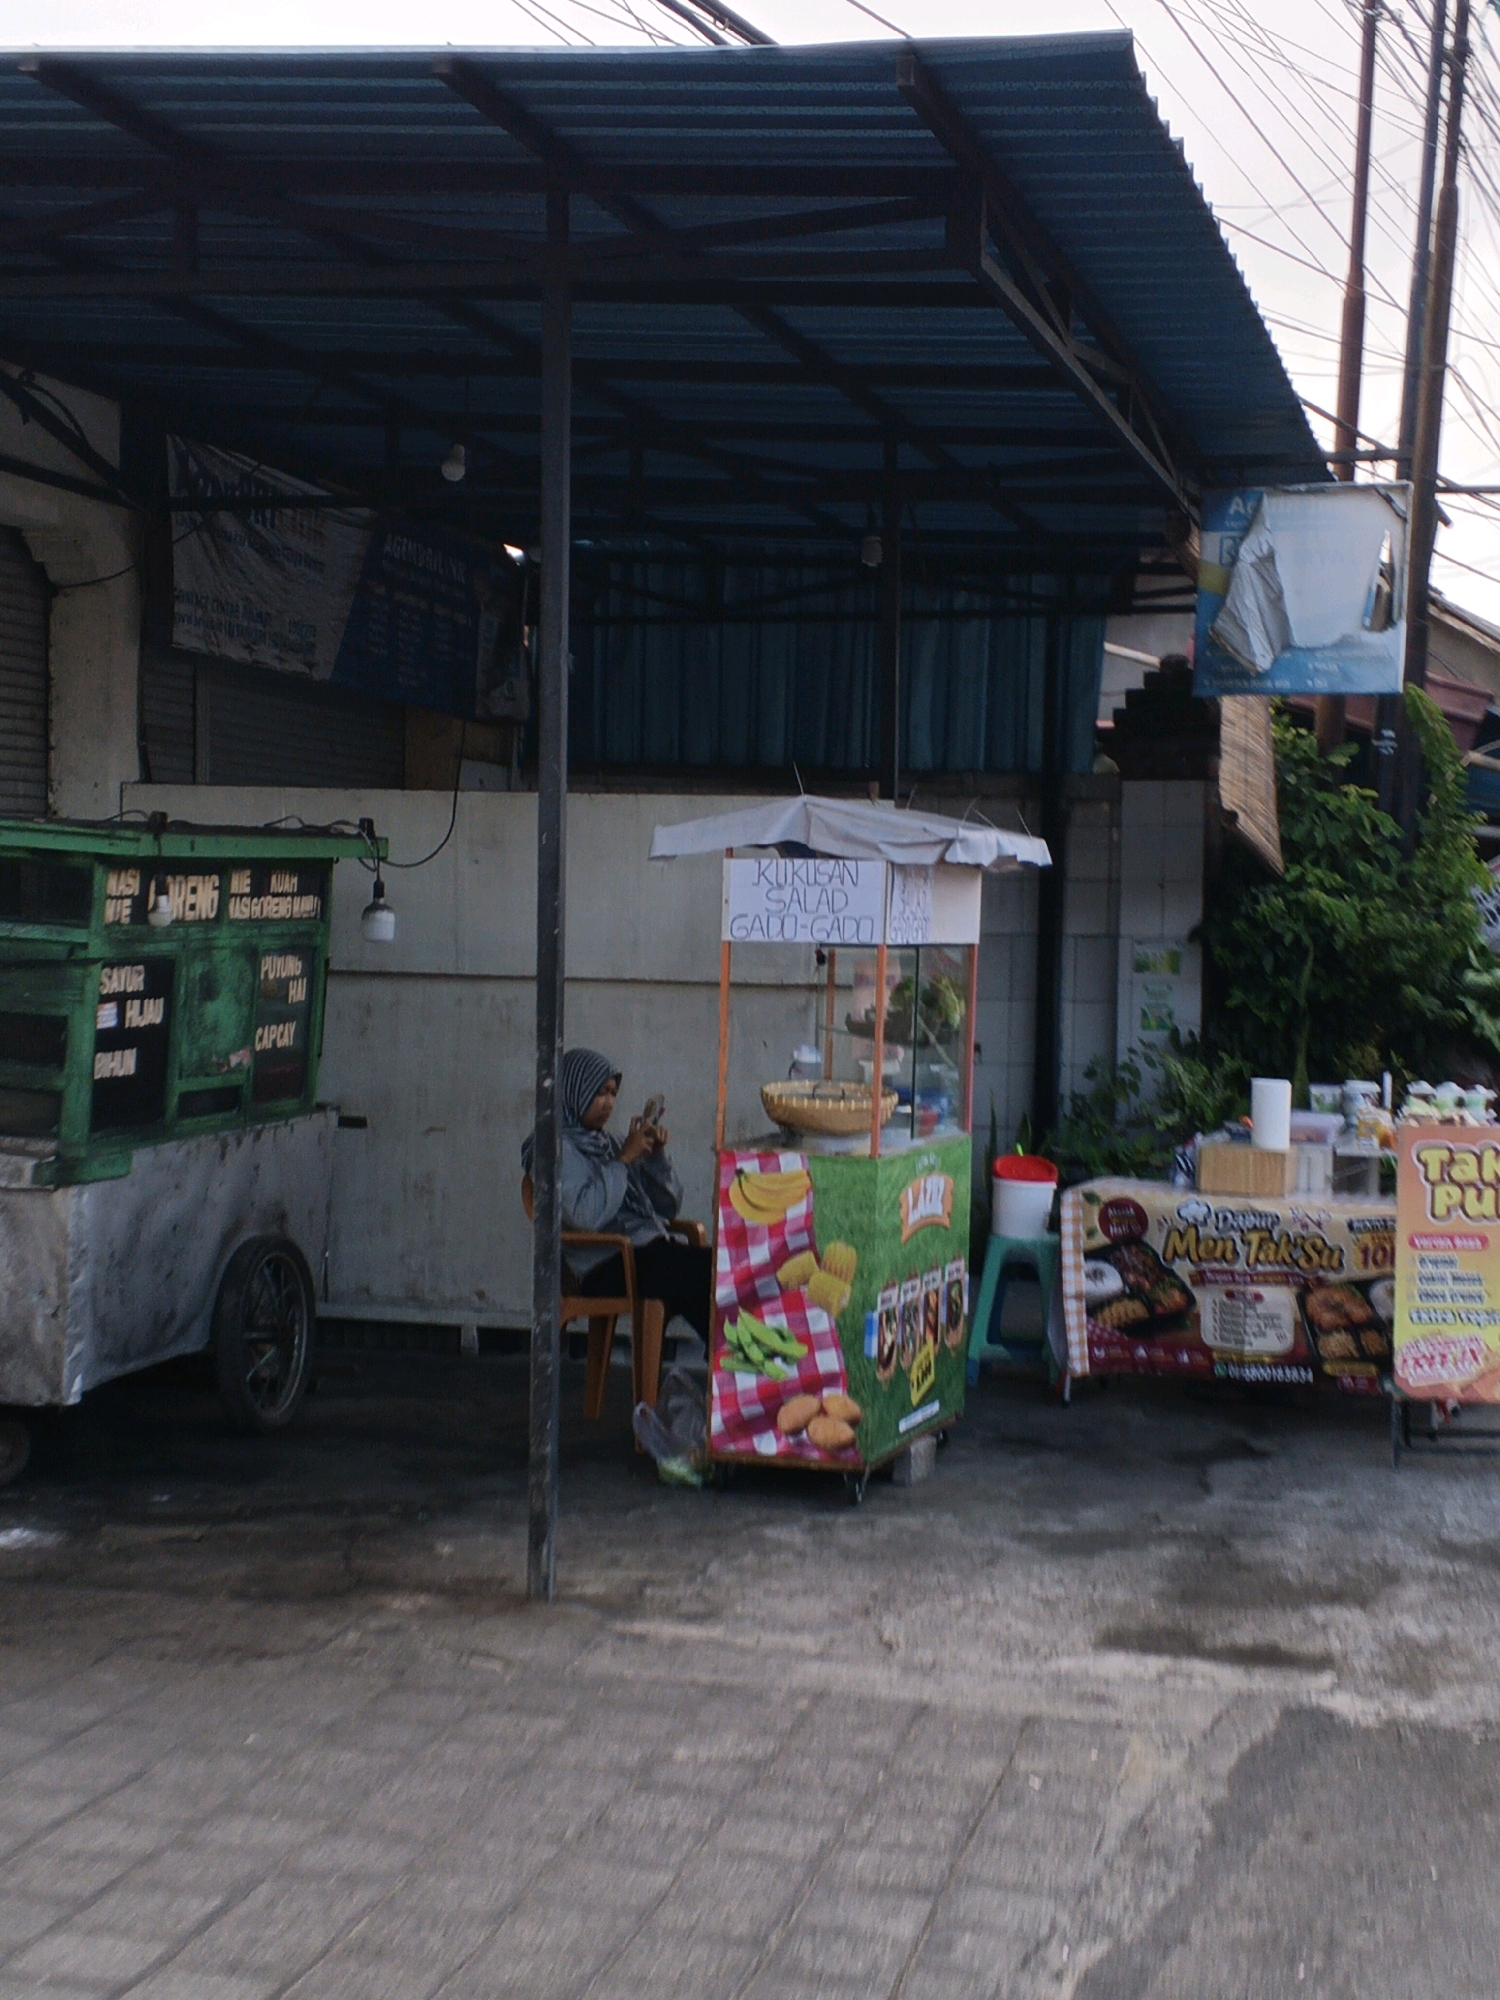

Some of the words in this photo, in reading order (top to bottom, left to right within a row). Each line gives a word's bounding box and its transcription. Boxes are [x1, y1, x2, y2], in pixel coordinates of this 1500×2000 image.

[752, 860, 859, 887] KUKUSAN
[251, 896, 292, 919] GORENG
[765, 888, 849, 914] SALAD
[100, 965, 145, 995] SAYUR
[261, 954, 303, 980] PUYUNG
[288, 976, 307, 1004] HAI
[125, 997, 164, 1029] HIJAU
[255, 1020, 297, 1052] CAPCAY
[94, 1047, 137, 1080] BIHUN
[1163, 1225, 1238, 1264] Men
